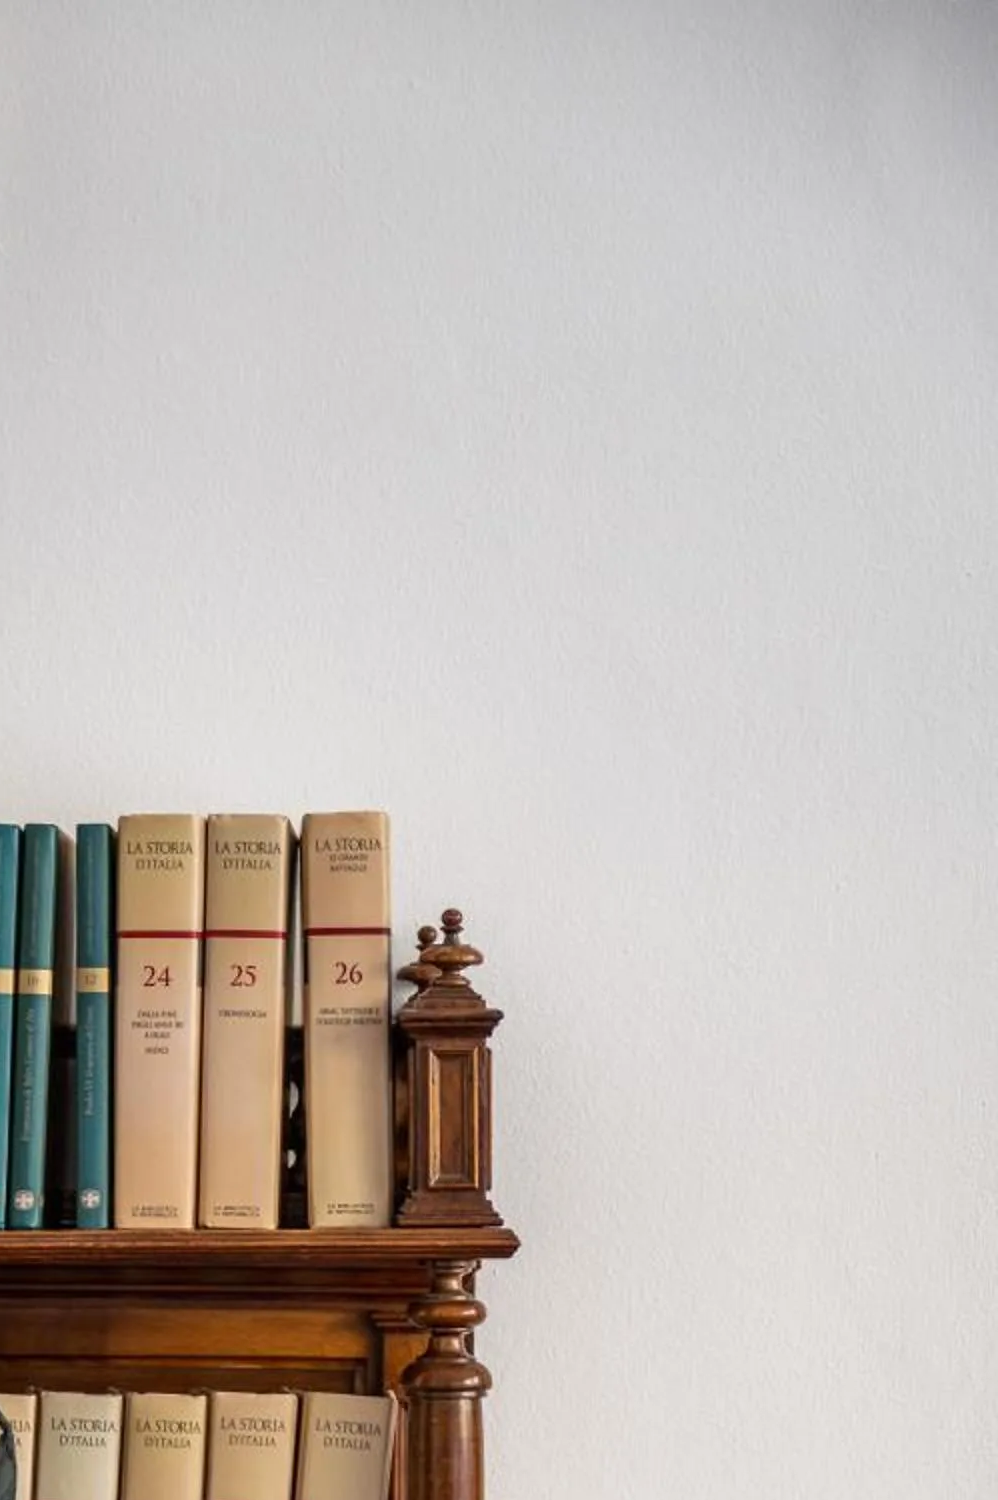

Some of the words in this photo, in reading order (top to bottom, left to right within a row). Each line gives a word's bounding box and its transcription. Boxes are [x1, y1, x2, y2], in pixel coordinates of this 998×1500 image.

[127, 841, 144, 854] LA
[147, 841, 193, 855] STORIA
[215, 841, 232, 854] LA
[235, 841, 282, 855] STORIA
[315, 838, 331, 851] LA
[335, 837, 381, 852] STORIA
[143, 965, 172, 987] 24
[230, 965, 257, 987] 25
[335, 962, 363, 985] 26
[52, 1418, 68, 1431] LA
[70, 1418, 117, 1432] STORIA
[136, 1418, 152, 1432] LA
[154, 1418, 201, 1434] STORIA
[221, 1417, 236, 1430] LA
[240, 1417, 285, 1432] STORIA
[315, 1419, 332, 1432] LA
[334, 1420, 381, 1436] STORIA
